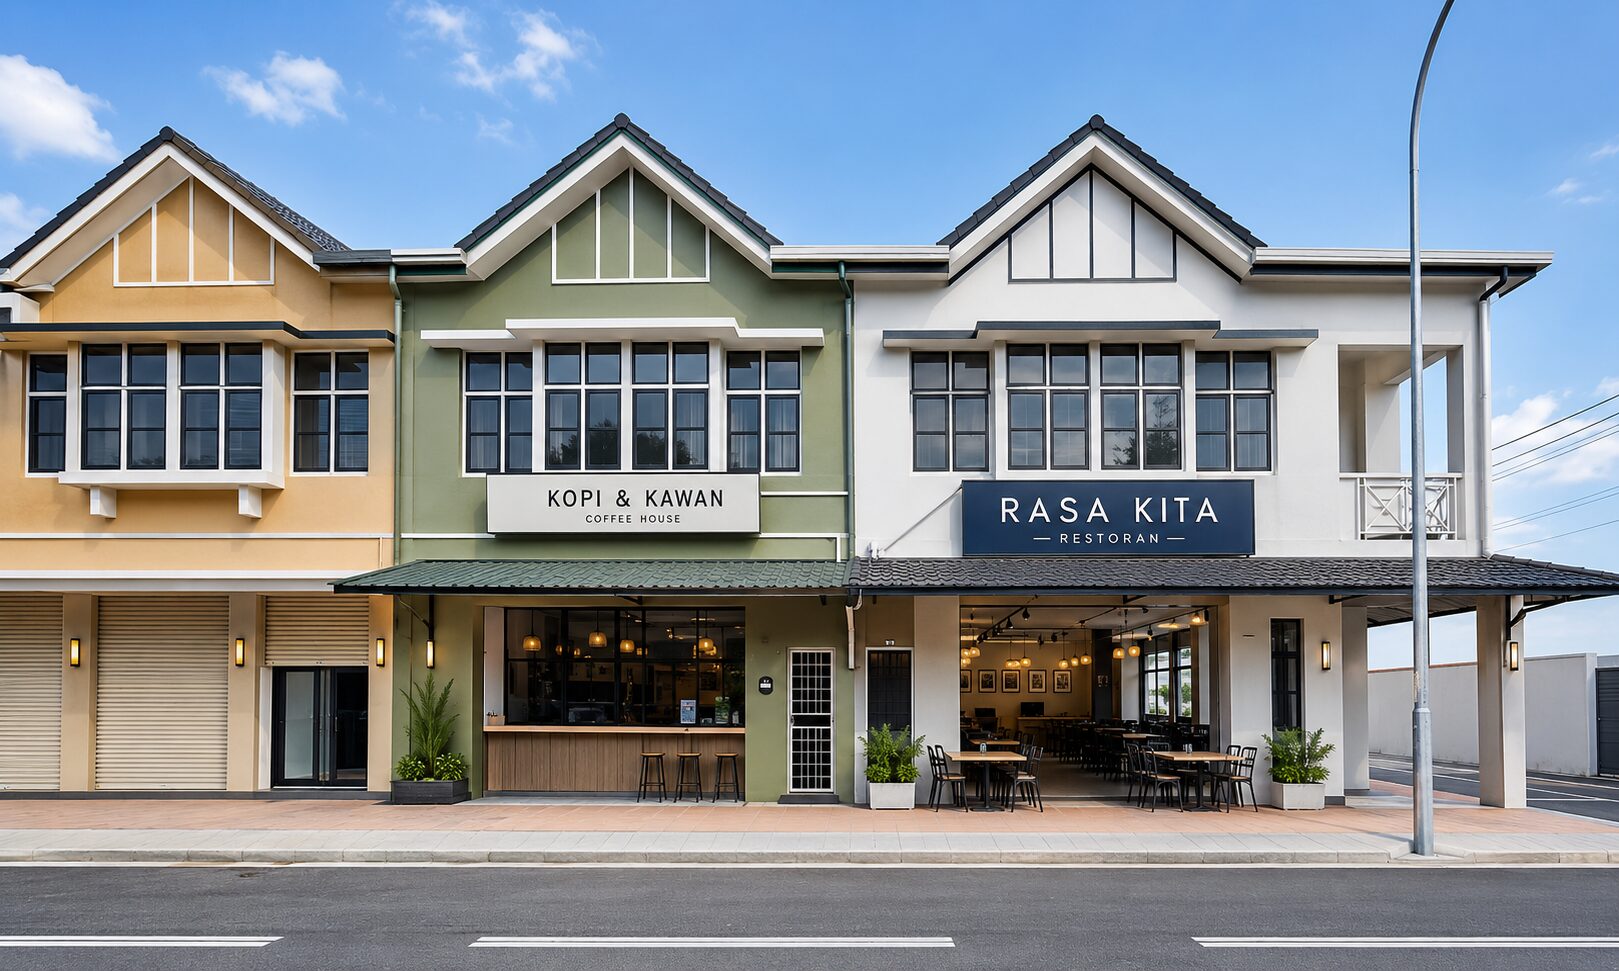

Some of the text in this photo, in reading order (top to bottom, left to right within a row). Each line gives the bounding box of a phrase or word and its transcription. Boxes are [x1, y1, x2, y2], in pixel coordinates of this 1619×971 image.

[548, 489, 723, 508] KOPI & KAWAN
[1001, 497, 1219, 523] RASA KITA
[585, 514, 681, 524] COFFEE HOUSE
[1060, 533, 1159, 544] RESTORAN
